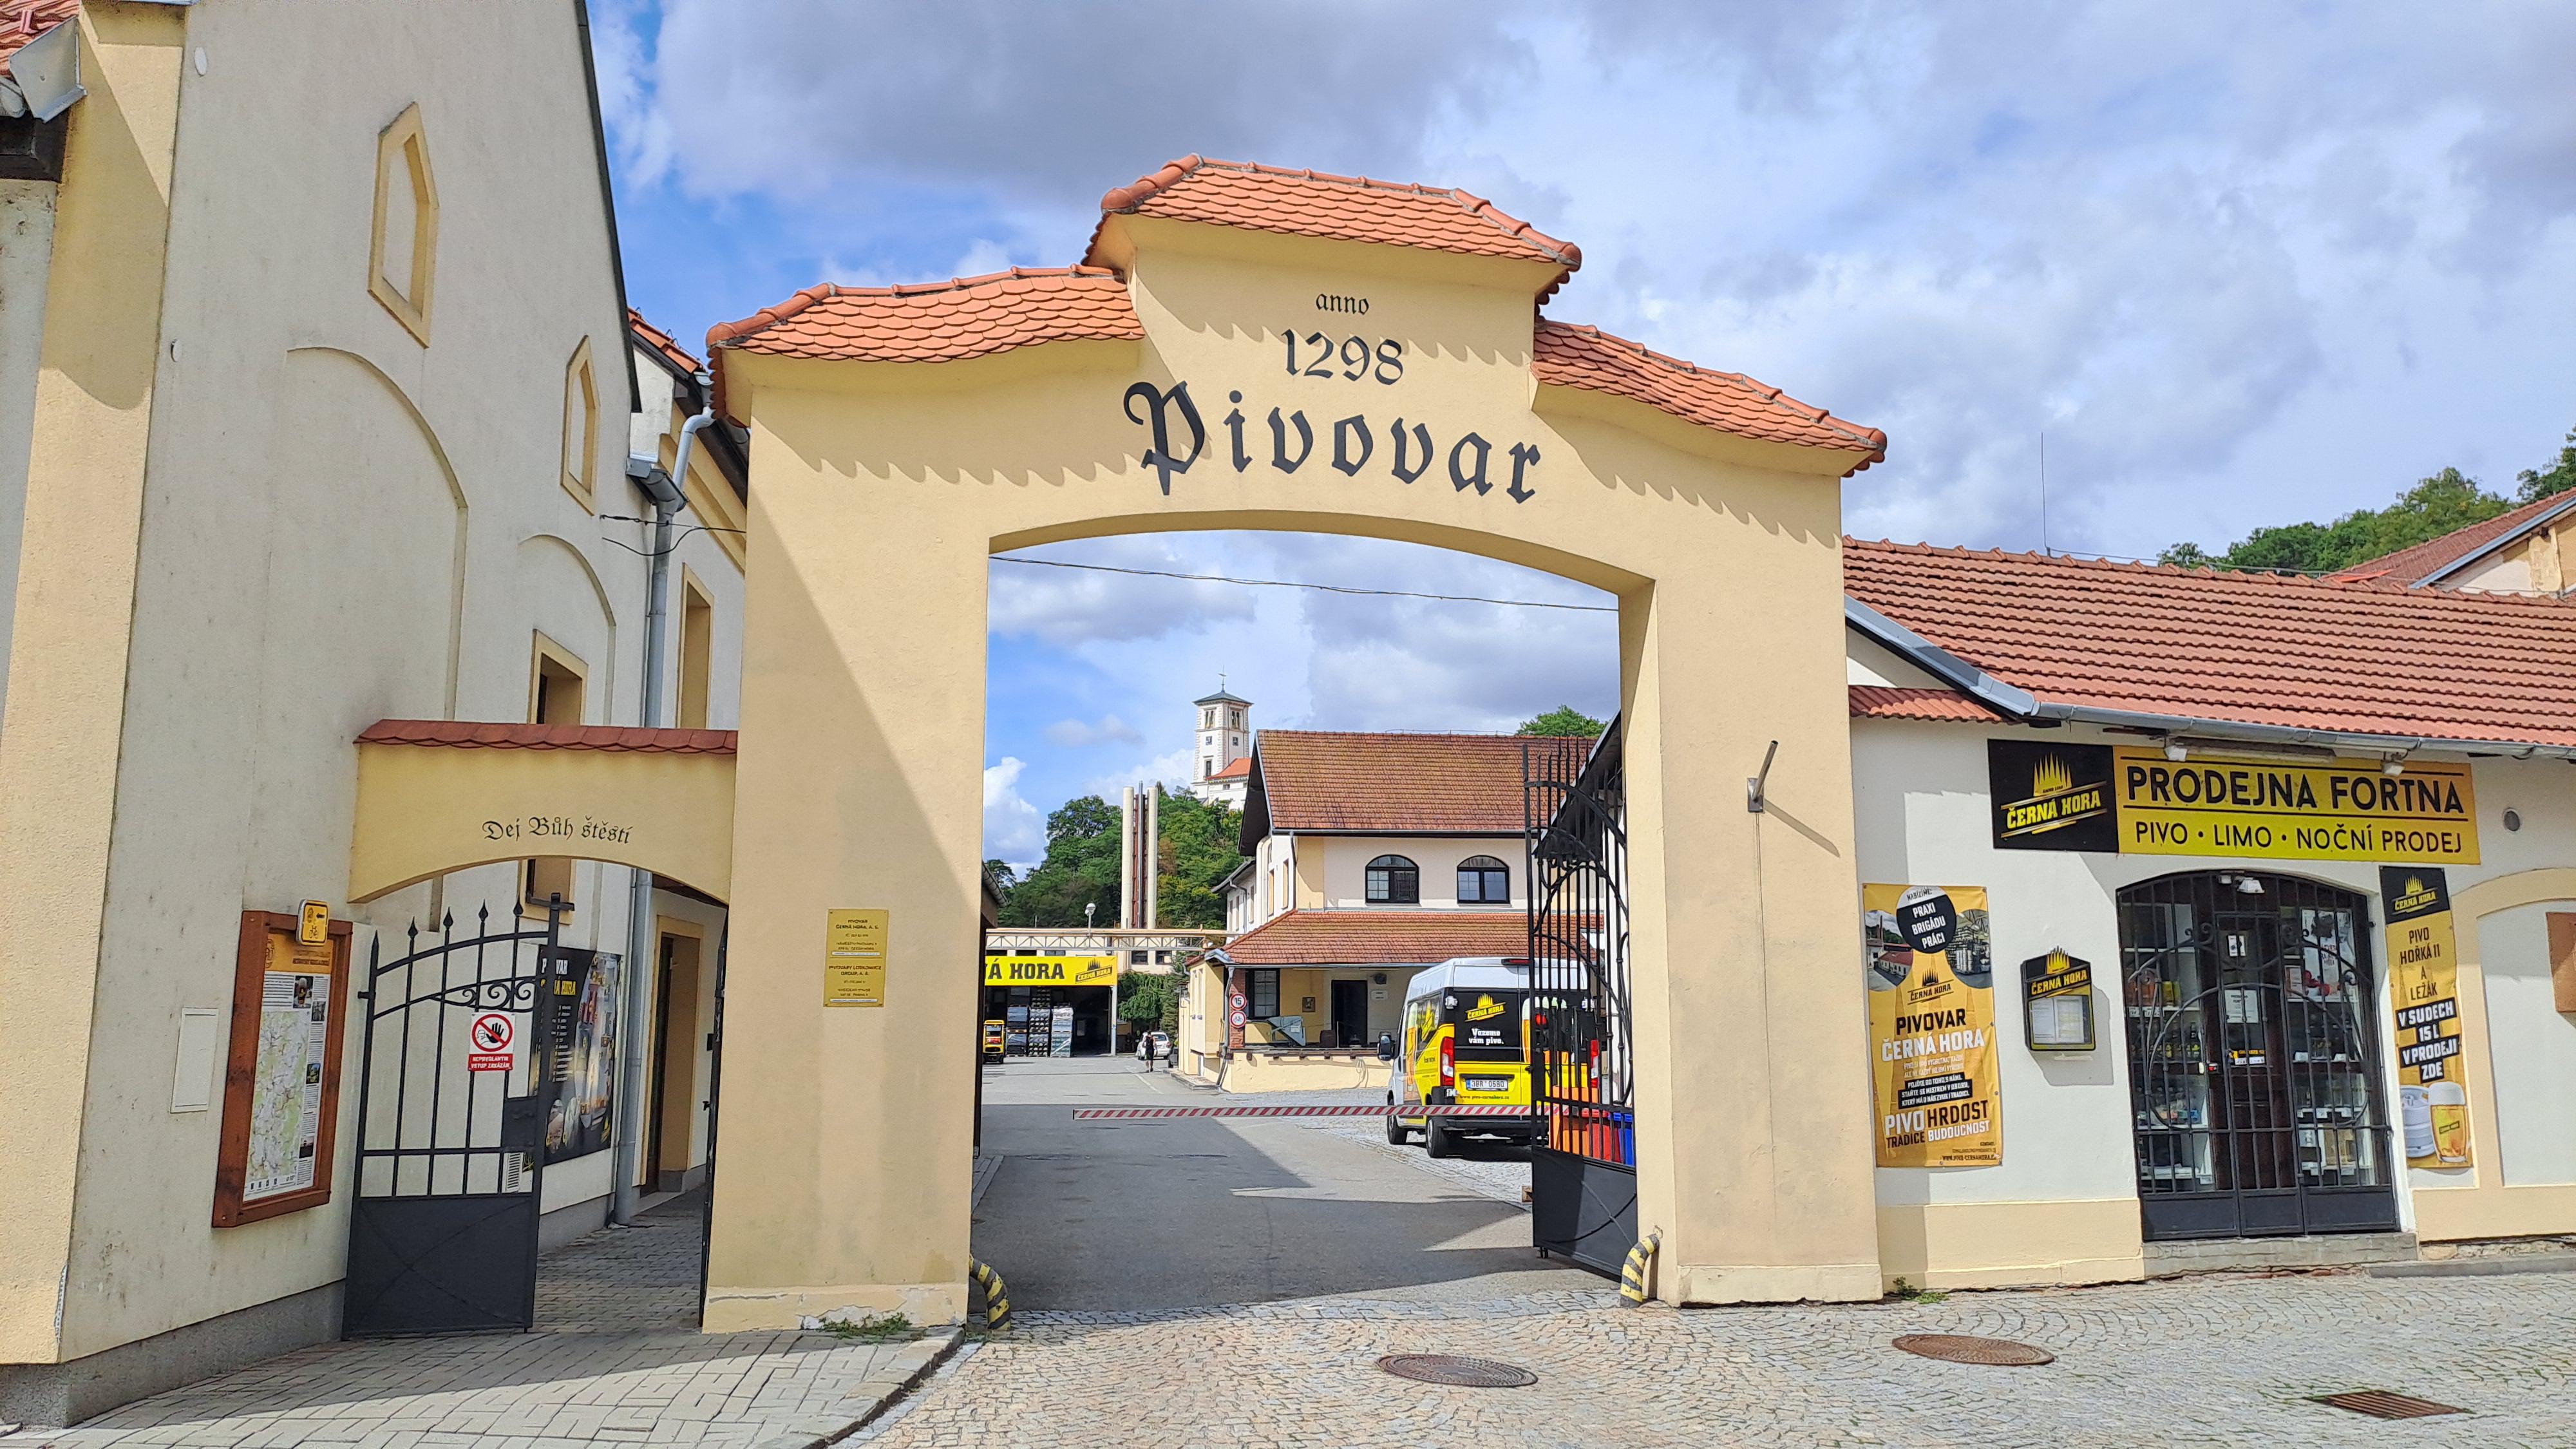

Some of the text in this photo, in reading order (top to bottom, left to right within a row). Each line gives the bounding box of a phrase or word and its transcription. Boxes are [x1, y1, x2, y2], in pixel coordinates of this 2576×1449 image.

[1315, 292, 1370, 315] anno
[1282, 328, 1403, 385] 1298
[1123, 380, 1542, 504] Pivovar
[2127, 766, 2465, 813] PRODEJNA FORTNA
[2007, 790, 2101, 829] ČERNÁ HORA
[482, 815, 634, 844] Dej Bůh štěstí
[2136, 820, 2461, 853] PIVO LIMO NOČNÍ PRODEJ
[1912, 902, 1936, 918] PRAXI
[2394, 891, 2436, 911] ČERNÁ HORA
[1911, 915, 1946, 935] BRIGÁDU
[2409, 927, 2429, 945] PIVO
[1922, 932, 1946, 949] PRÁCI
[2400, 943, 2432, 965] HOŘKÁ
[1009, 963, 1065, 980] HORA
[2031, 969, 2087, 995] ČERNÁ HORA
[2421, 965, 2427, 980] A
[1235, 997, 1242, 1005] 15
[1910, 983, 1951, 1001] ČERNÁ HORA
[2410, 981, 2438, 1000] LEŽÁK
[1467, 1005, 1504, 1019] ČERNÁ HORA
[1896, 1008, 1966, 1035] PIVOVAR
[2398, 1001, 2454, 1027] V SUDECH
[2418, 1023, 2439, 1042] 15 L
[1882, 1028, 1985, 1062] ČERNÁ HORA
[2402, 1038, 2458, 1065] V PRODEJI
[2421, 1061, 2443, 1081] ZDE
[1884, 1100, 1988, 1136] PIVO HRDOST
[1886, 1120, 1990, 1148] TRADICE BUDOUCNOST
